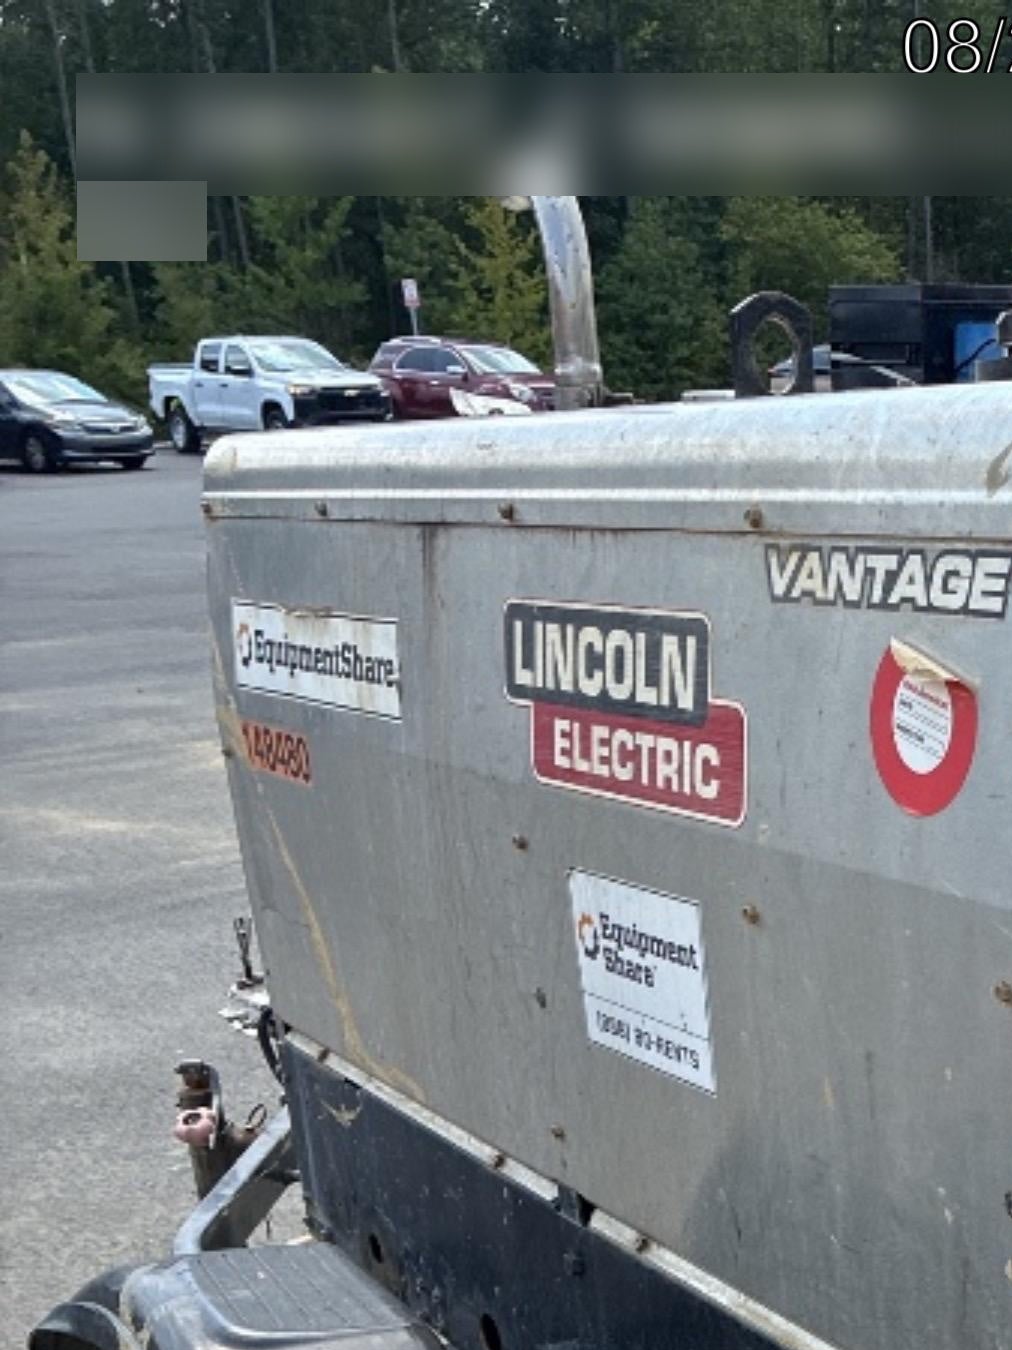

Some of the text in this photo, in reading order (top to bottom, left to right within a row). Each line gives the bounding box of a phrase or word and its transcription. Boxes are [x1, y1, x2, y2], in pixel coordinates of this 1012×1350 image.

[513, 619, 697, 712] LINCOLN
[553, 717, 720, 800] ELECTRIC
[600, 912, 699, 970] Equipment
[602, 947, 656, 988] Share
